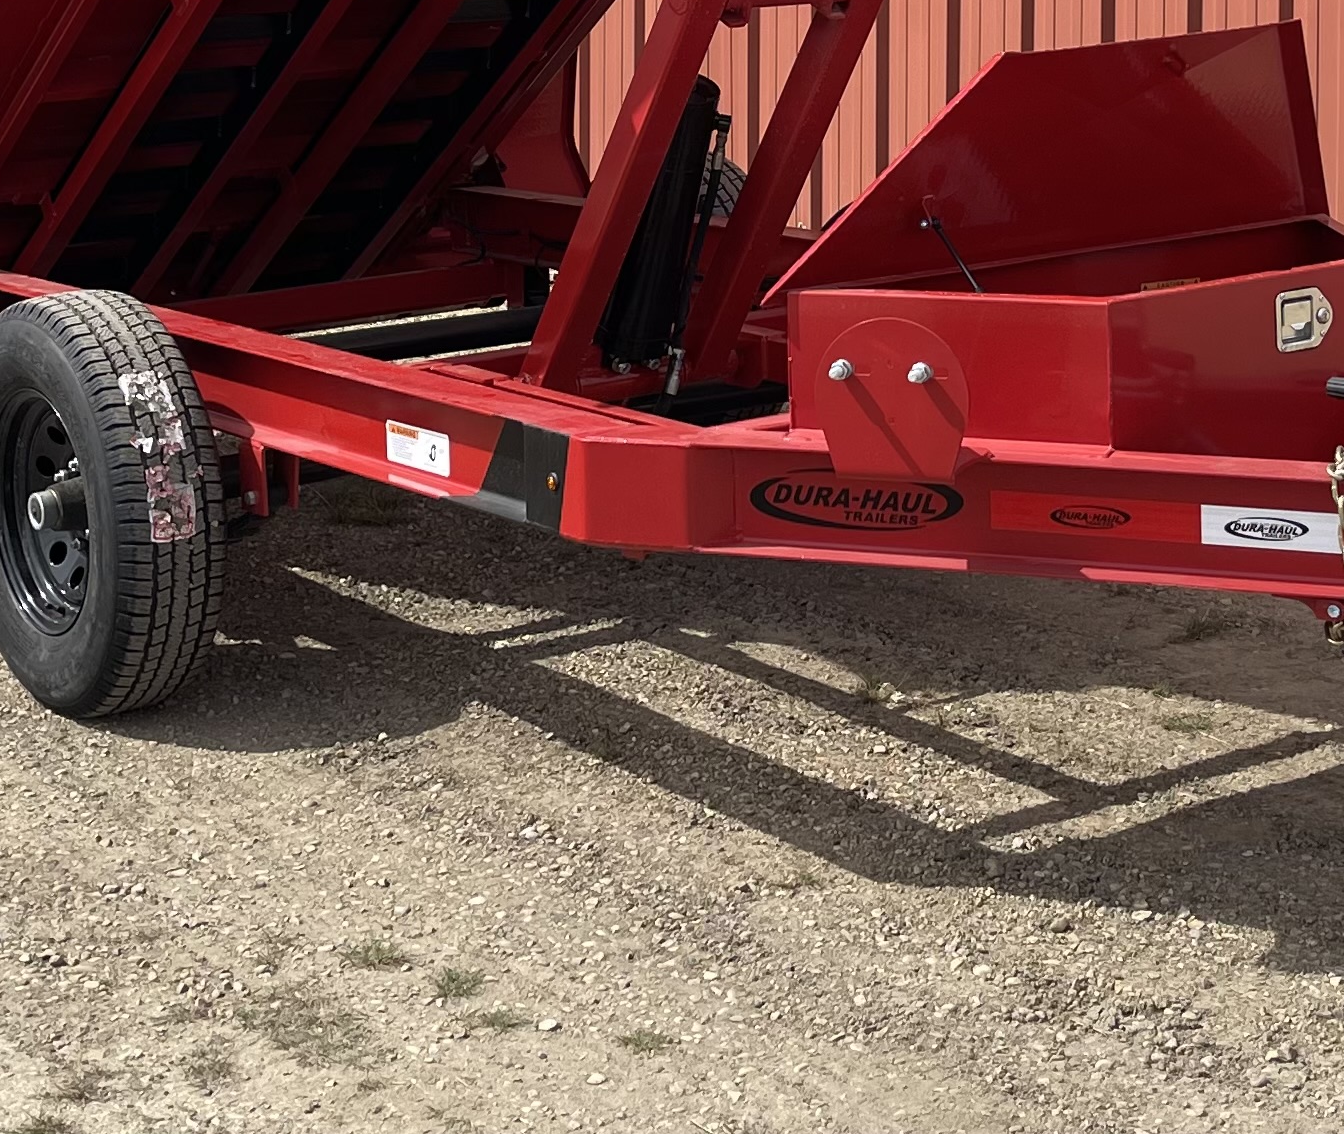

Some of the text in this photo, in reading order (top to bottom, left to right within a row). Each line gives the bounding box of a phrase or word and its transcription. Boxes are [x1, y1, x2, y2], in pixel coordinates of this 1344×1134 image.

[772, 483, 938, 515] DURA-HAUL
[843, 510, 919, 526] TRAILERS
[1232, 522, 1300, 537] DURA-HAUL
